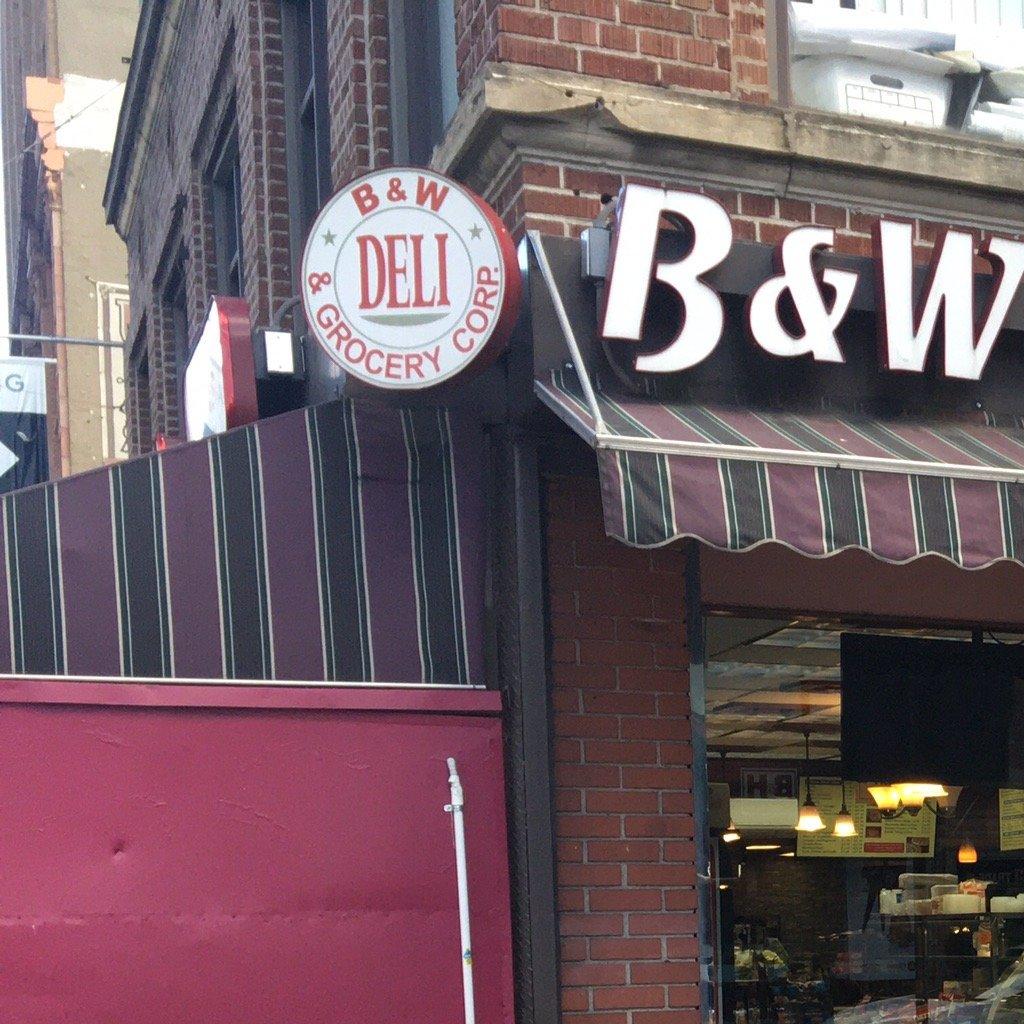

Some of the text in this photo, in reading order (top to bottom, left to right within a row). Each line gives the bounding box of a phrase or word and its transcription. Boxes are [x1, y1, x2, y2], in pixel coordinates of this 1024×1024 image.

[350, 182, 380, 216] B
[414, 175, 450, 212] W
[356, 233, 451, 310] DELI
[307, 266, 499, 380] & GROCERY CORP.
